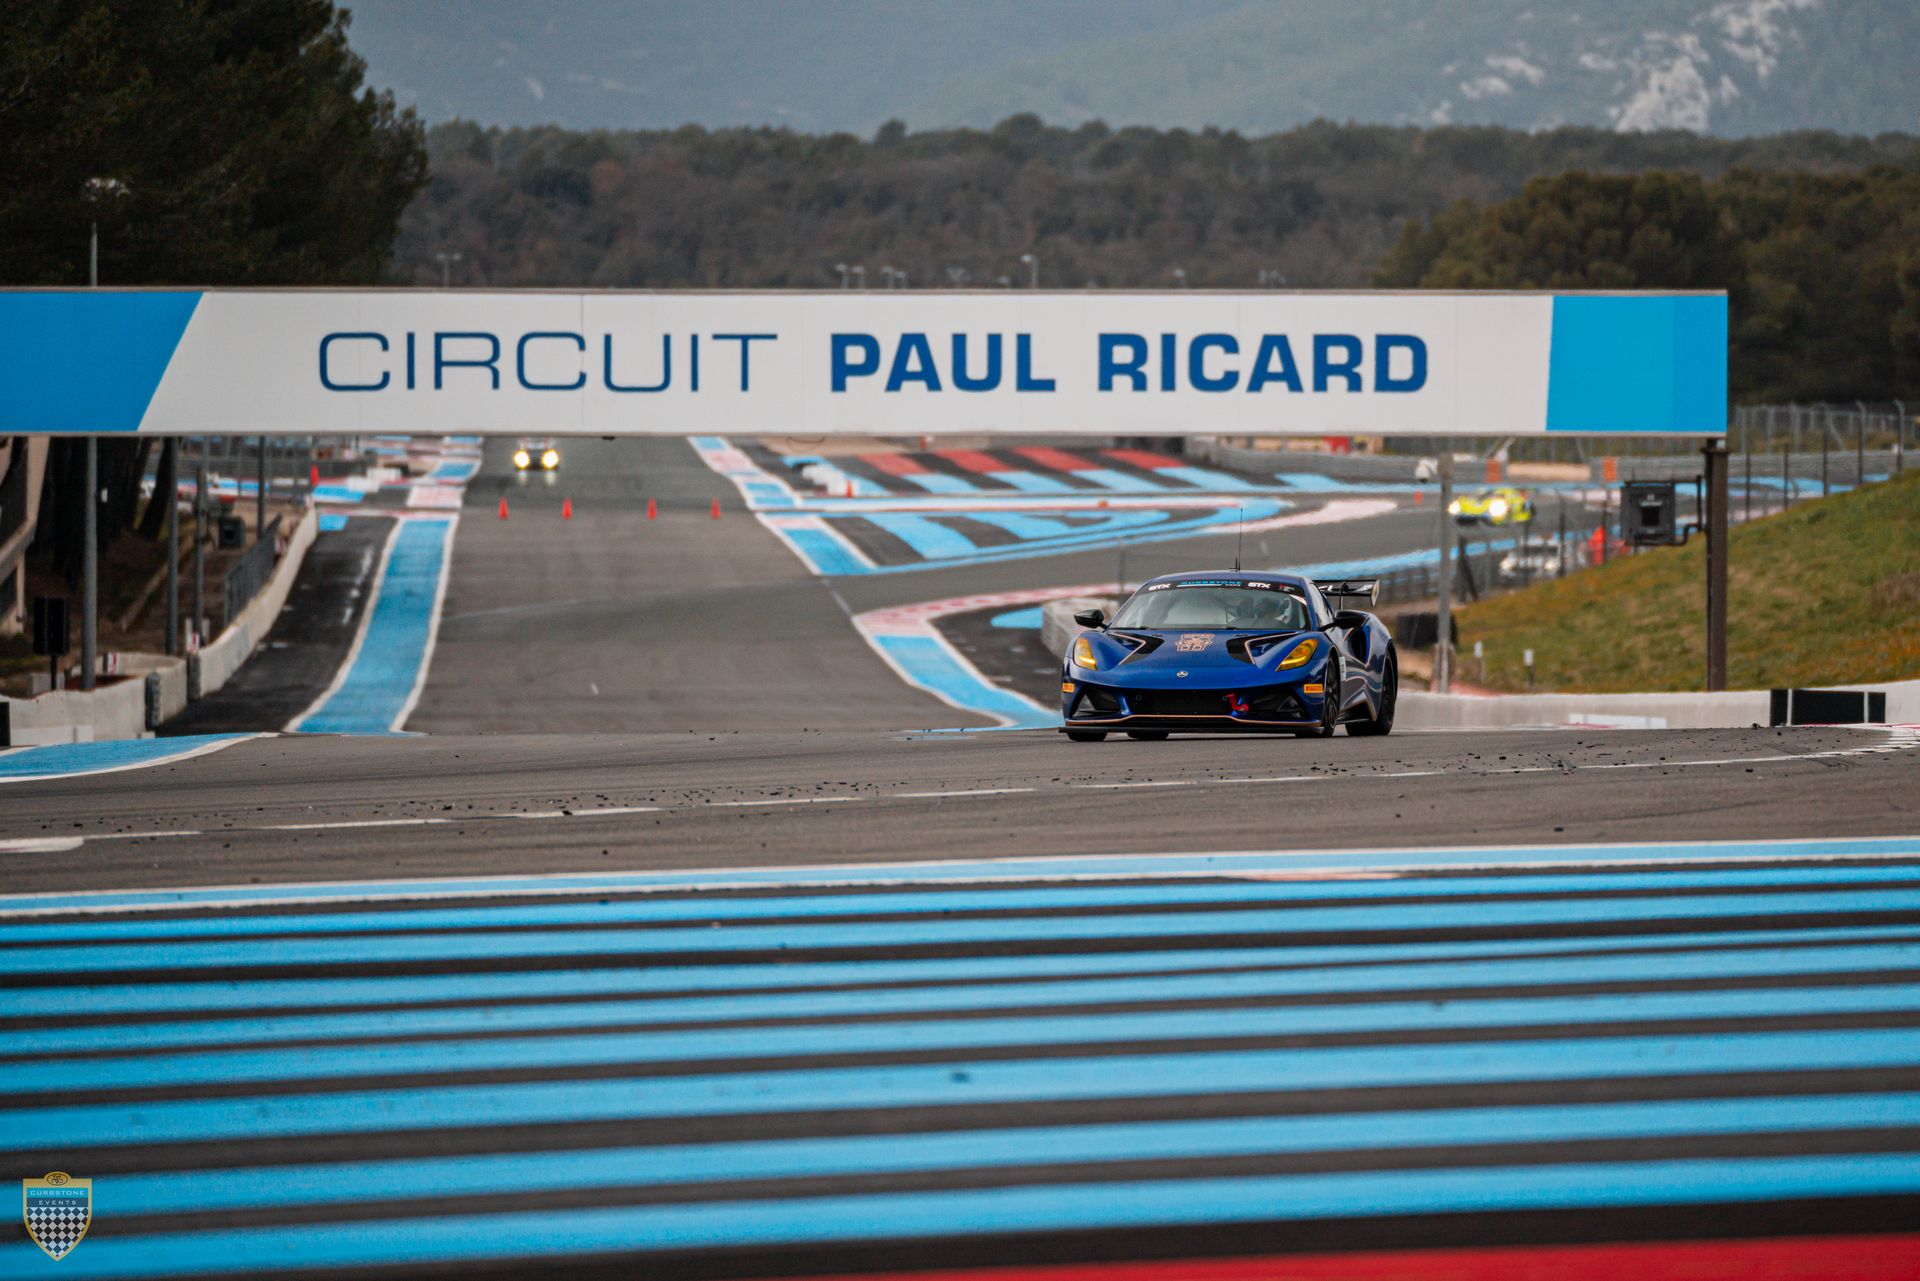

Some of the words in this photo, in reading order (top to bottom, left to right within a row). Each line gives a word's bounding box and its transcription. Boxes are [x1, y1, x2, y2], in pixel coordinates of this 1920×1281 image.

[318, 330, 778, 393] CIRCUIT
[831, 332, 1056, 392] PAUL
[1098, 332, 1428, 393] RICARD
